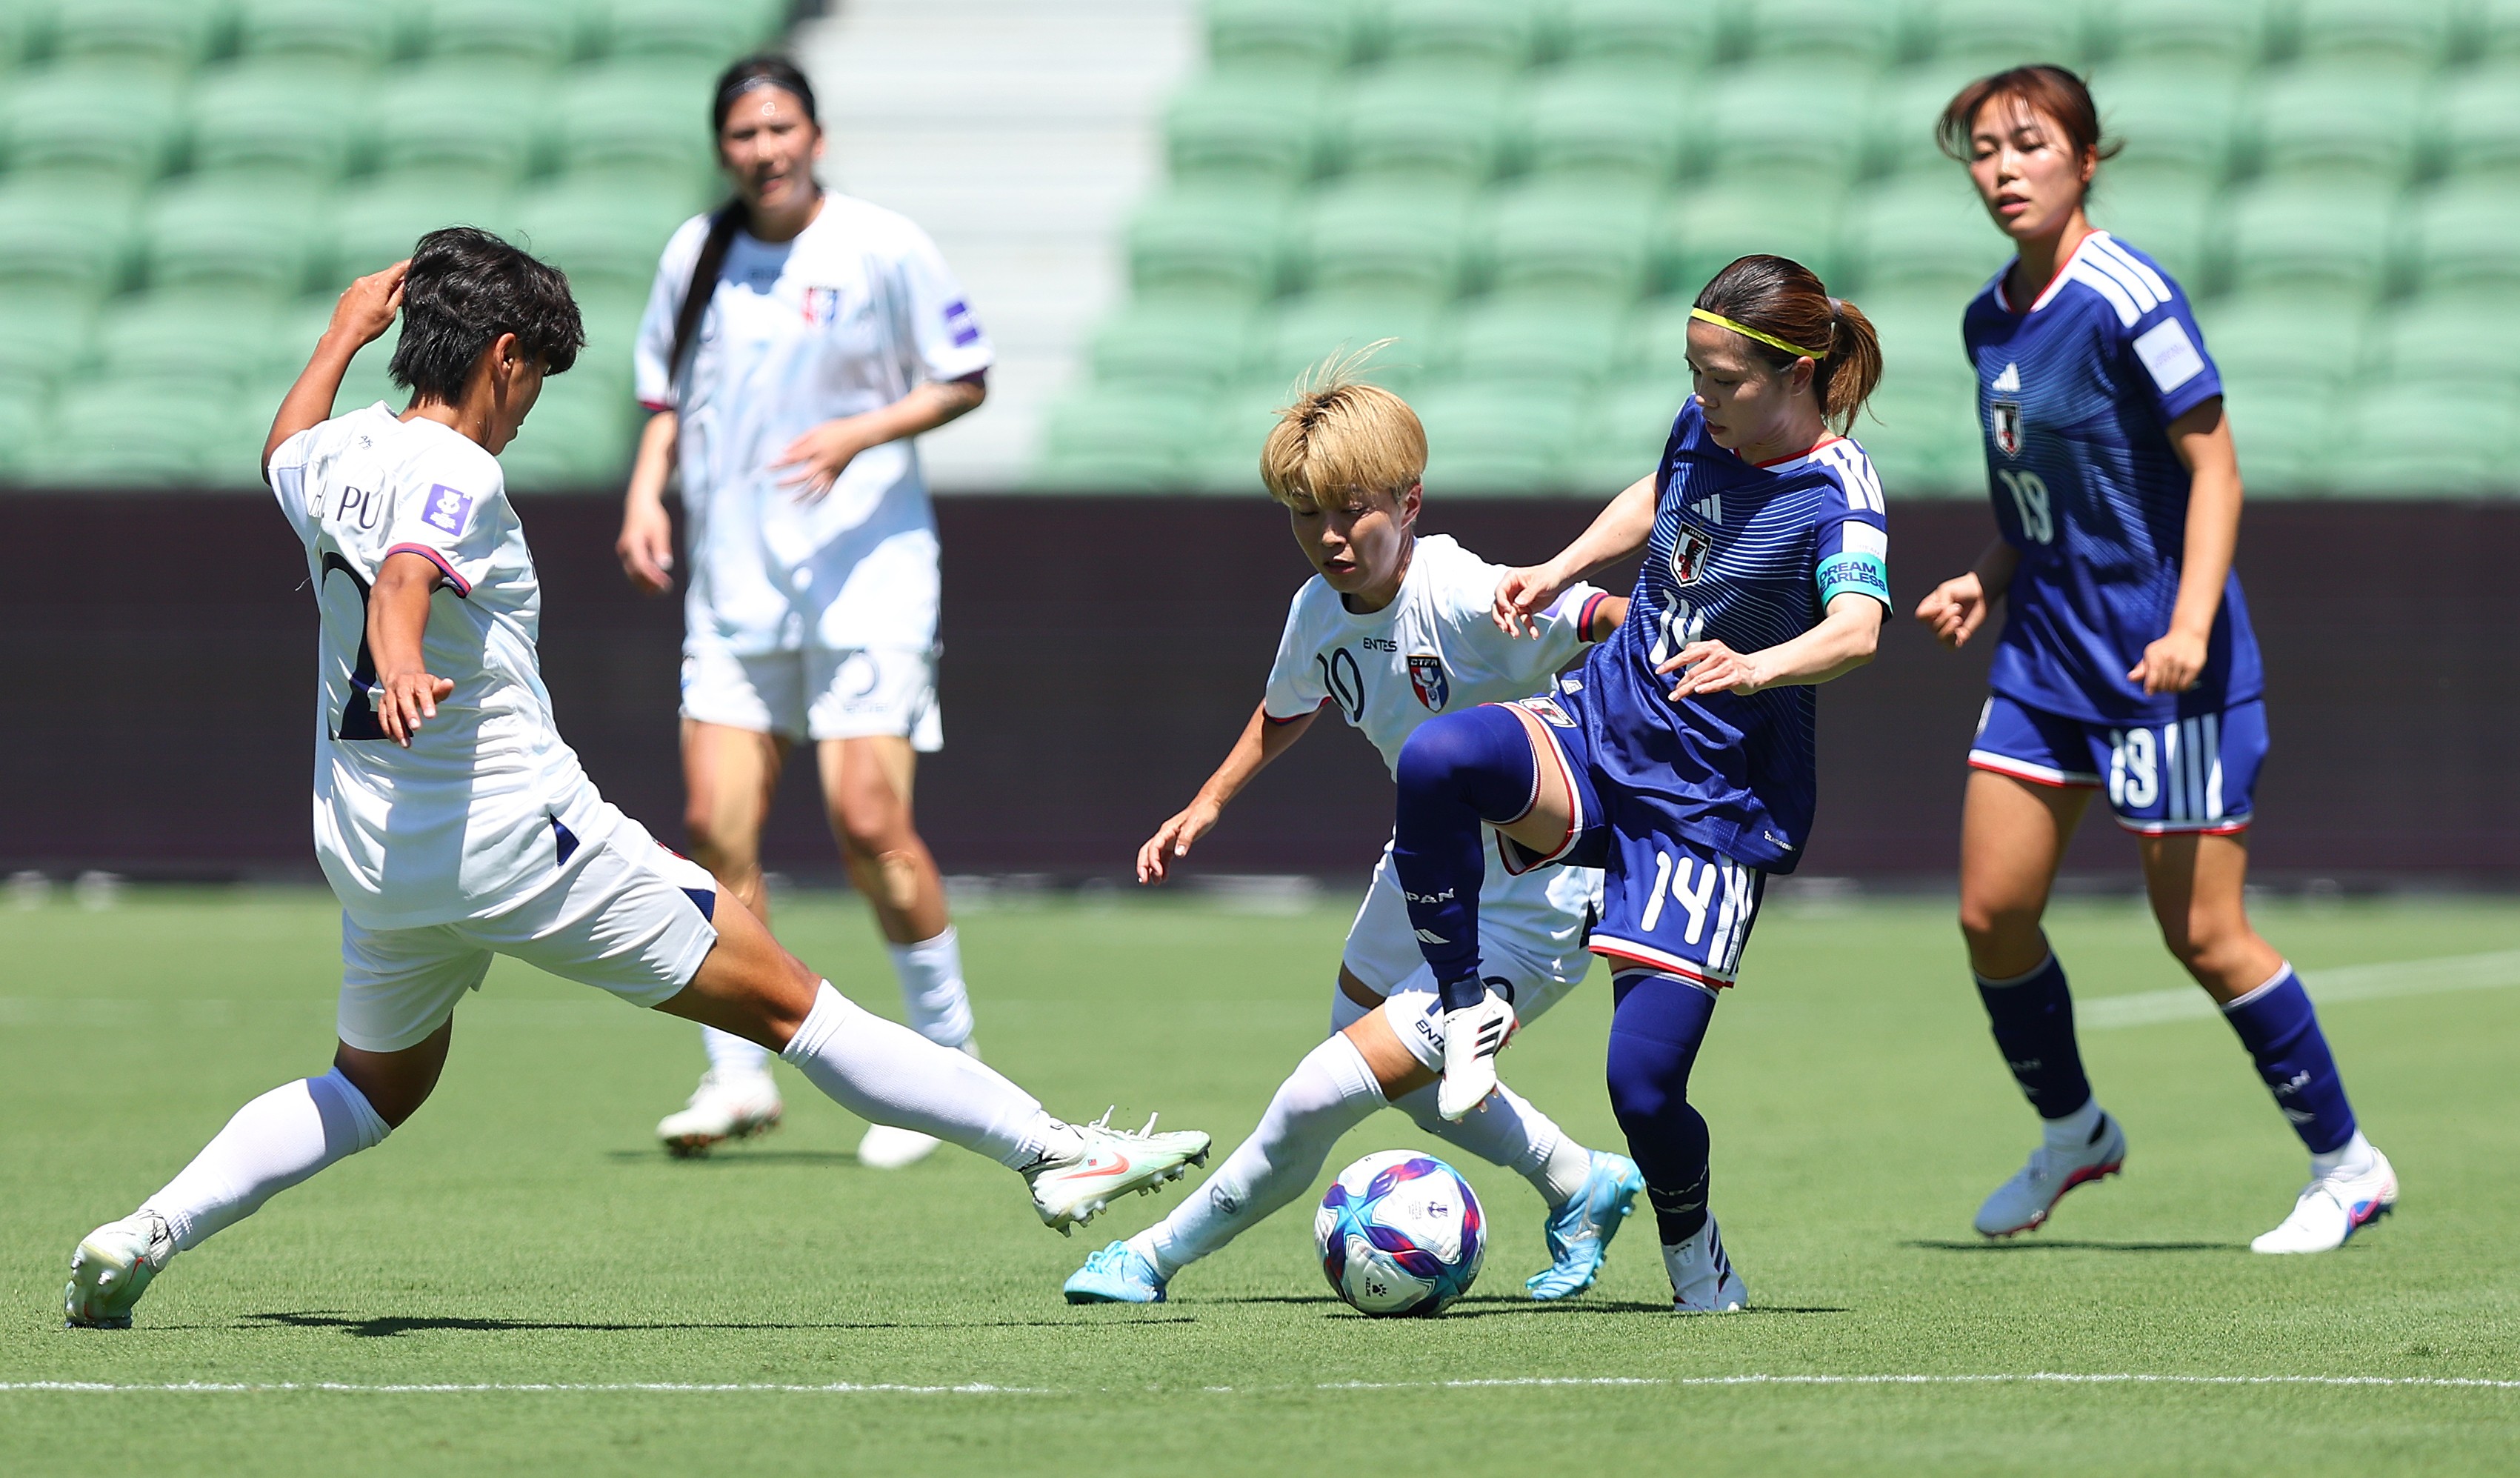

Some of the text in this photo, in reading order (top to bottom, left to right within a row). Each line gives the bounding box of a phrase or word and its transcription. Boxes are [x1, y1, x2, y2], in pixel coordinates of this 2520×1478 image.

[336, 485, 384, 529] PU
[1997, 468, 2054, 545] 19
[1688, 528, 1705, 540] JAPAN
[1819, 562, 1877, 584] DREAM
[1819, 571, 1887, 593] EARLESS
[1363, 637, 1398, 652] ENTES
[1649, 588, 1704, 676] 14
[1410, 658, 1439, 667] CTFA
[1316, 647, 1364, 722] 10
[2109, 727, 2159, 809] 19
[1405, 888, 1454, 903] PAN
[1641, 850, 1718, 945] 14
[1415, 1019, 1445, 1053] ENT
